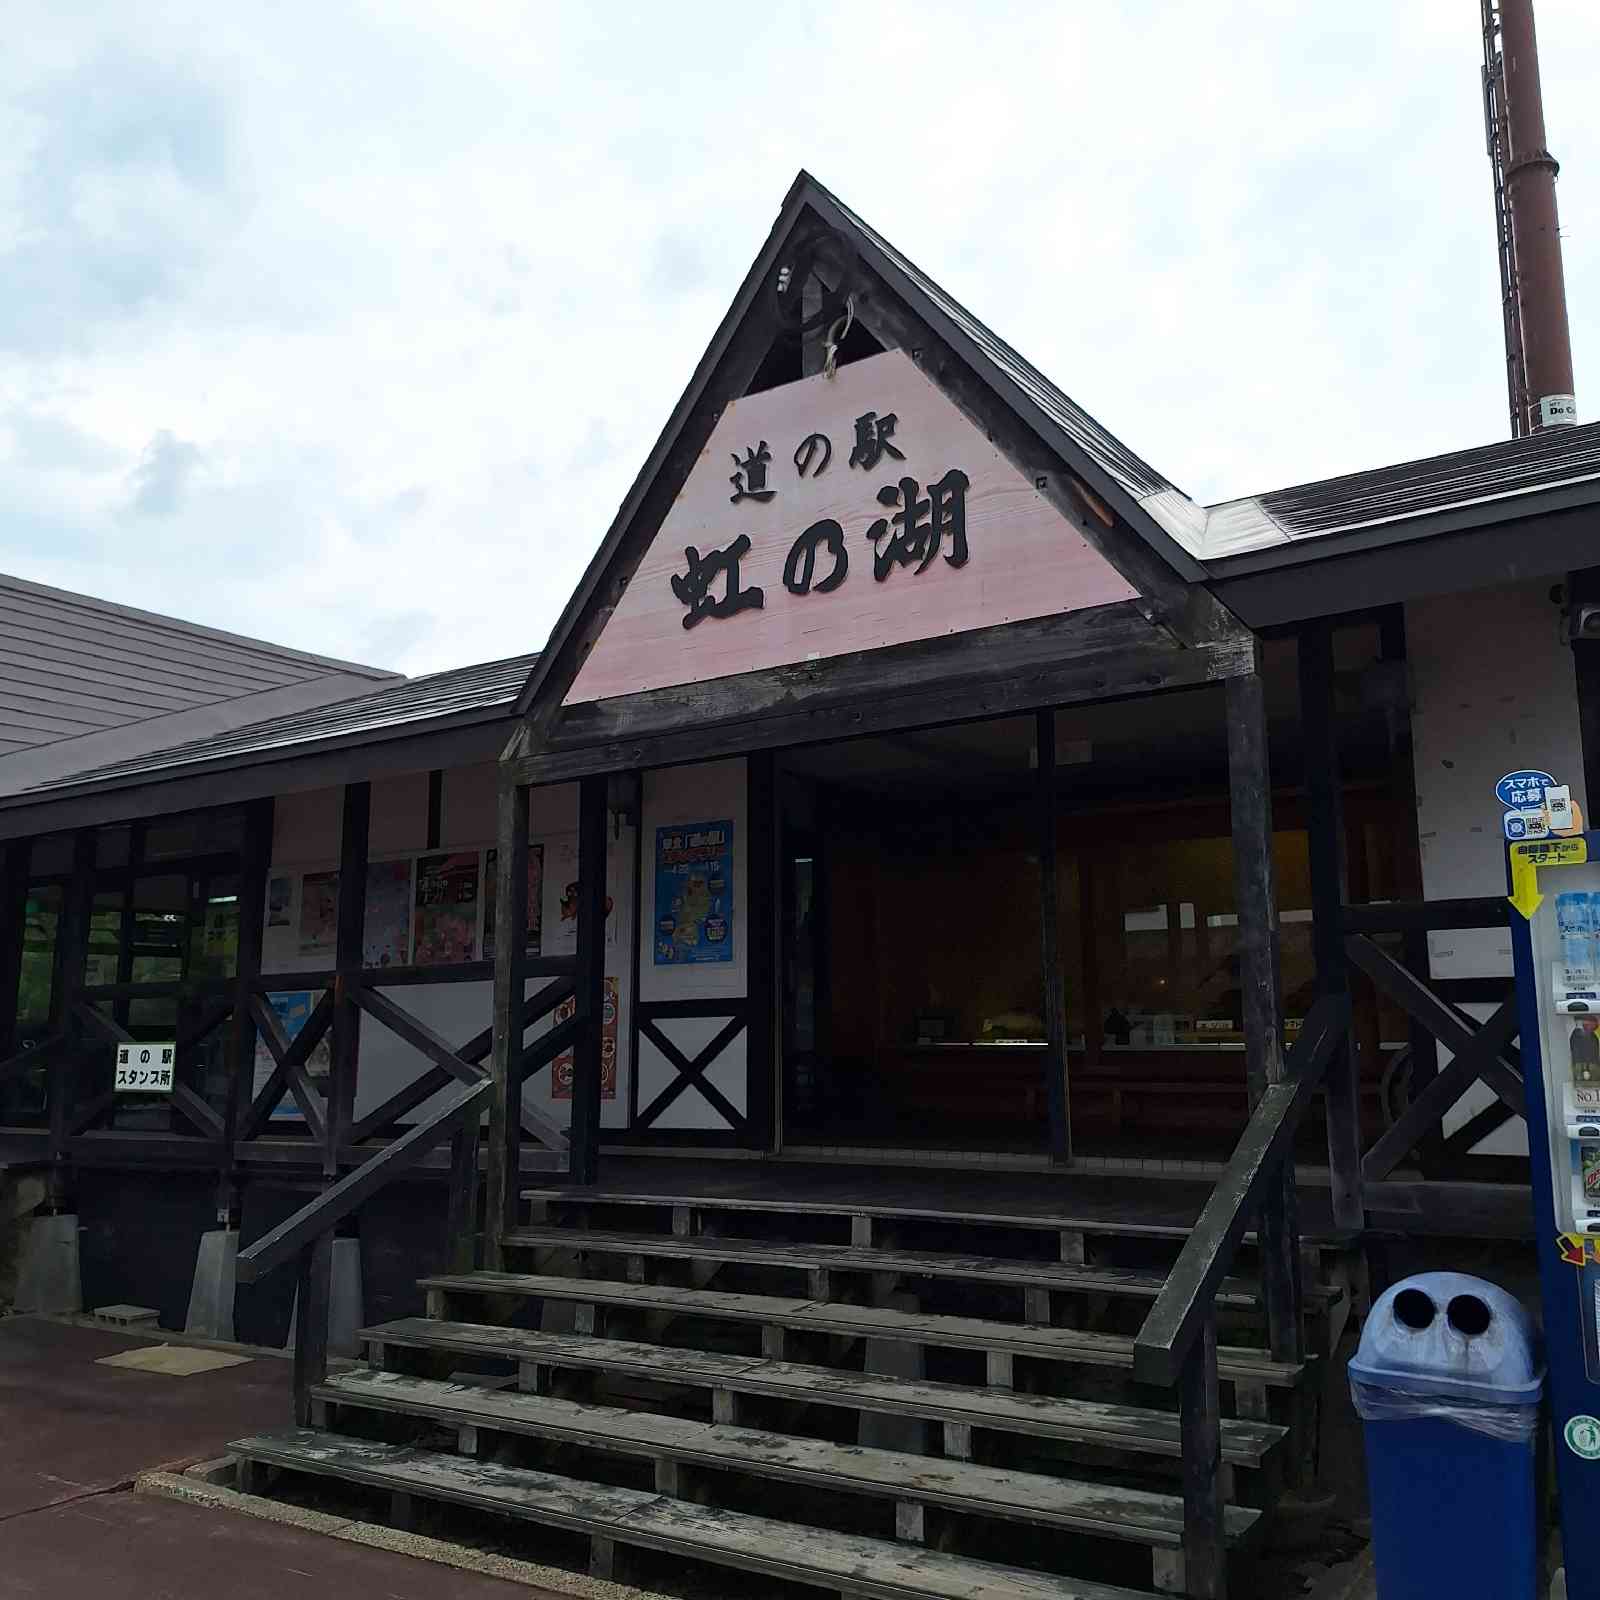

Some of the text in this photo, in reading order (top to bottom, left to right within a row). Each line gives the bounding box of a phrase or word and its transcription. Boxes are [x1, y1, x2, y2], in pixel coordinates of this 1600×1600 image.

[729, 411, 906, 504] 道の駅
[671, 468, 970, 630] 虹の湖
[1504, 777, 1550, 790] スマホで
[1511, 788, 1542, 804] 応募
[1528, 852, 1567, 864] スタート
[119, 1049, 172, 1064] 道の駅
